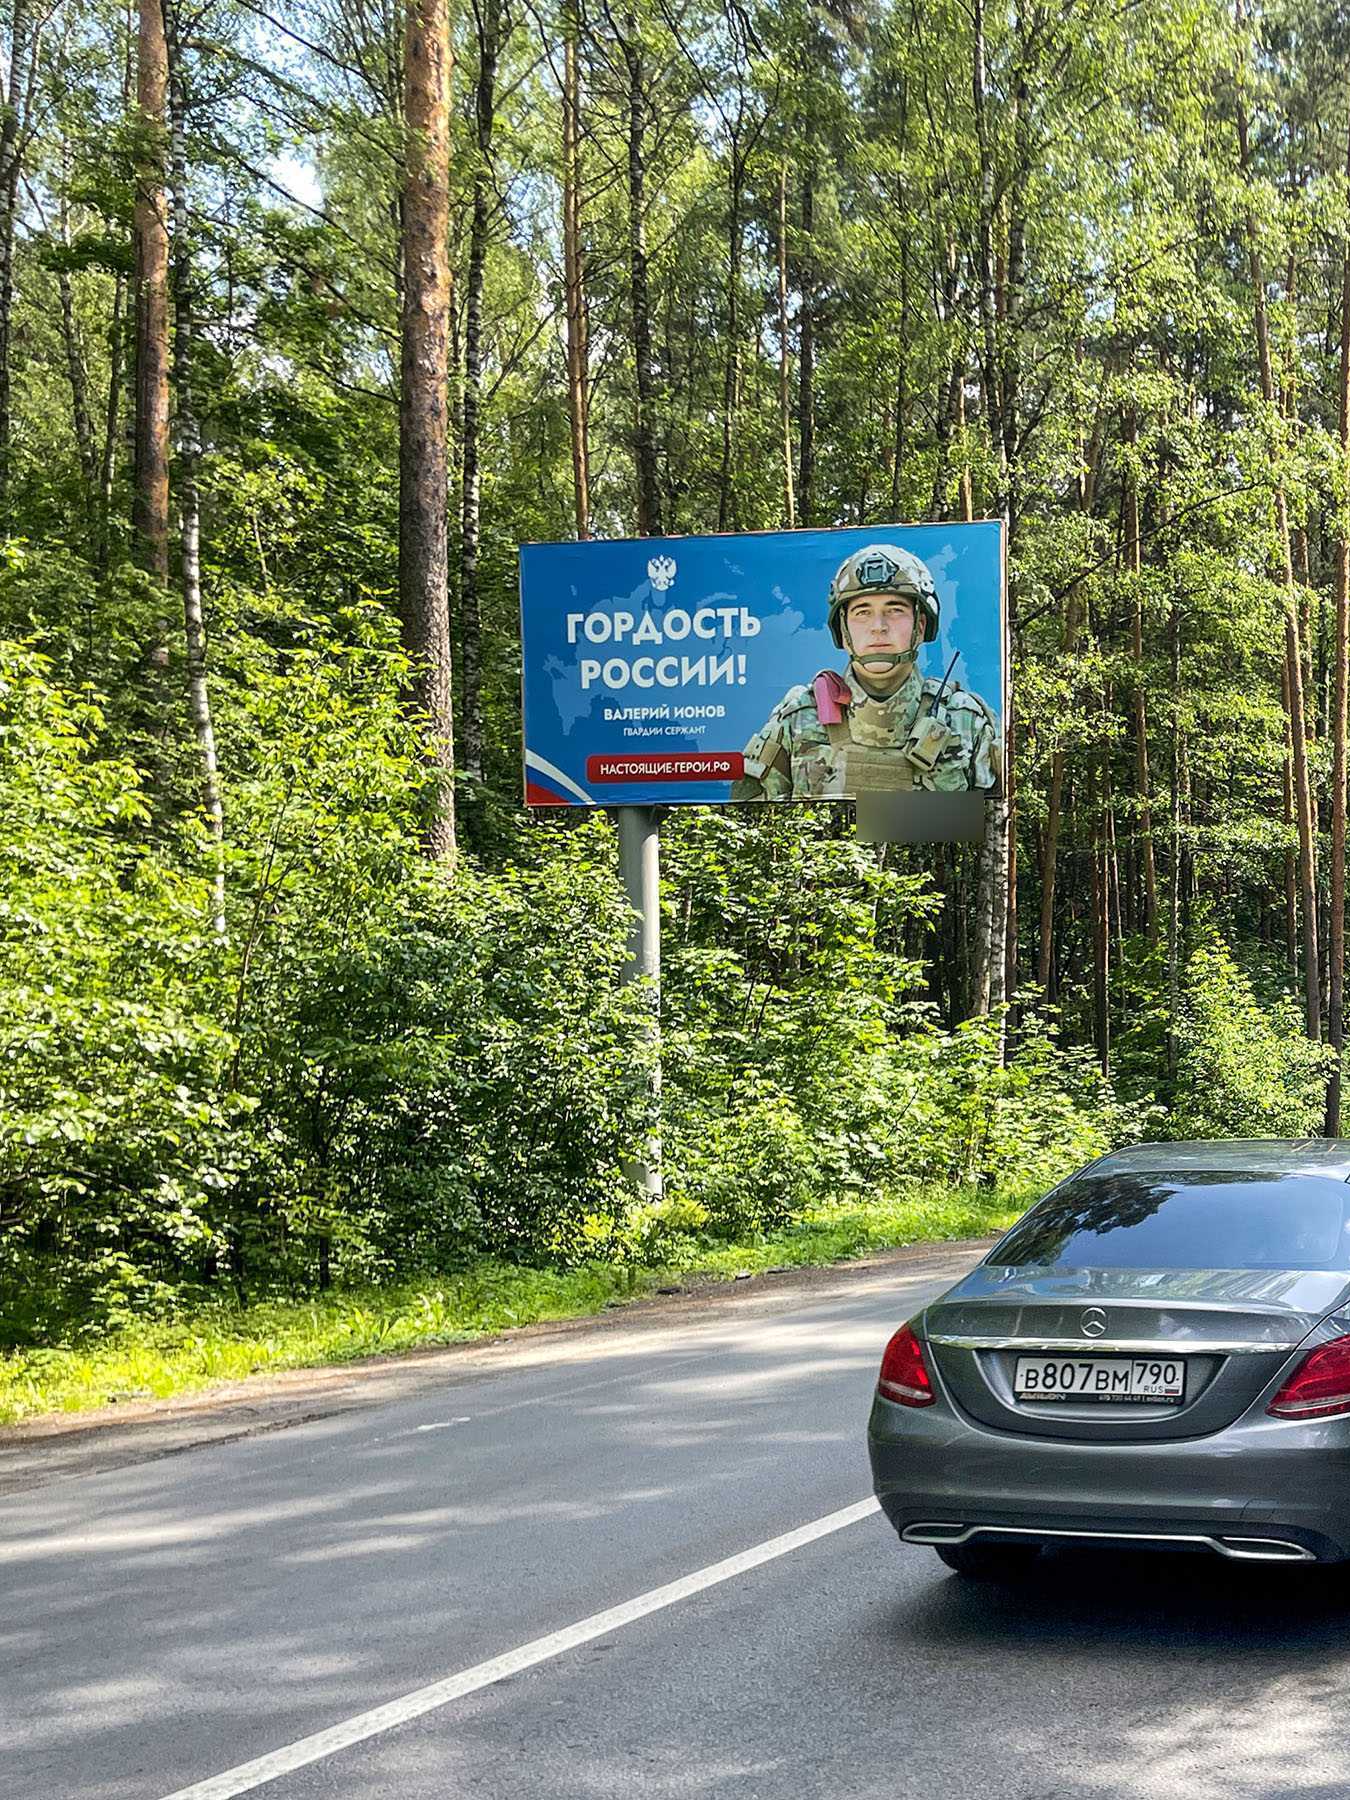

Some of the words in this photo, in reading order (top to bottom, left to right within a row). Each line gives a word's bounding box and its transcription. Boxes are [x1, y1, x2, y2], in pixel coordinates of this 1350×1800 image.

[567, 607, 761, 645] ГОРДОСТЬ
[581, 654, 746, 689] РОССИИ!
[604, 704, 669, 720] ВАЛЕРИЙ
[674, 705, 726, 718] ИОНОВ
[624, 726, 663, 737] ГВАРДИИ
[665, 725, 706, 736] СЕРЖАНТ
[600, 761, 730, 775] НАСТОЯЩИЕ-ГЕРОИ.РФ
[1136, 1363, 1176, 1384] 790
